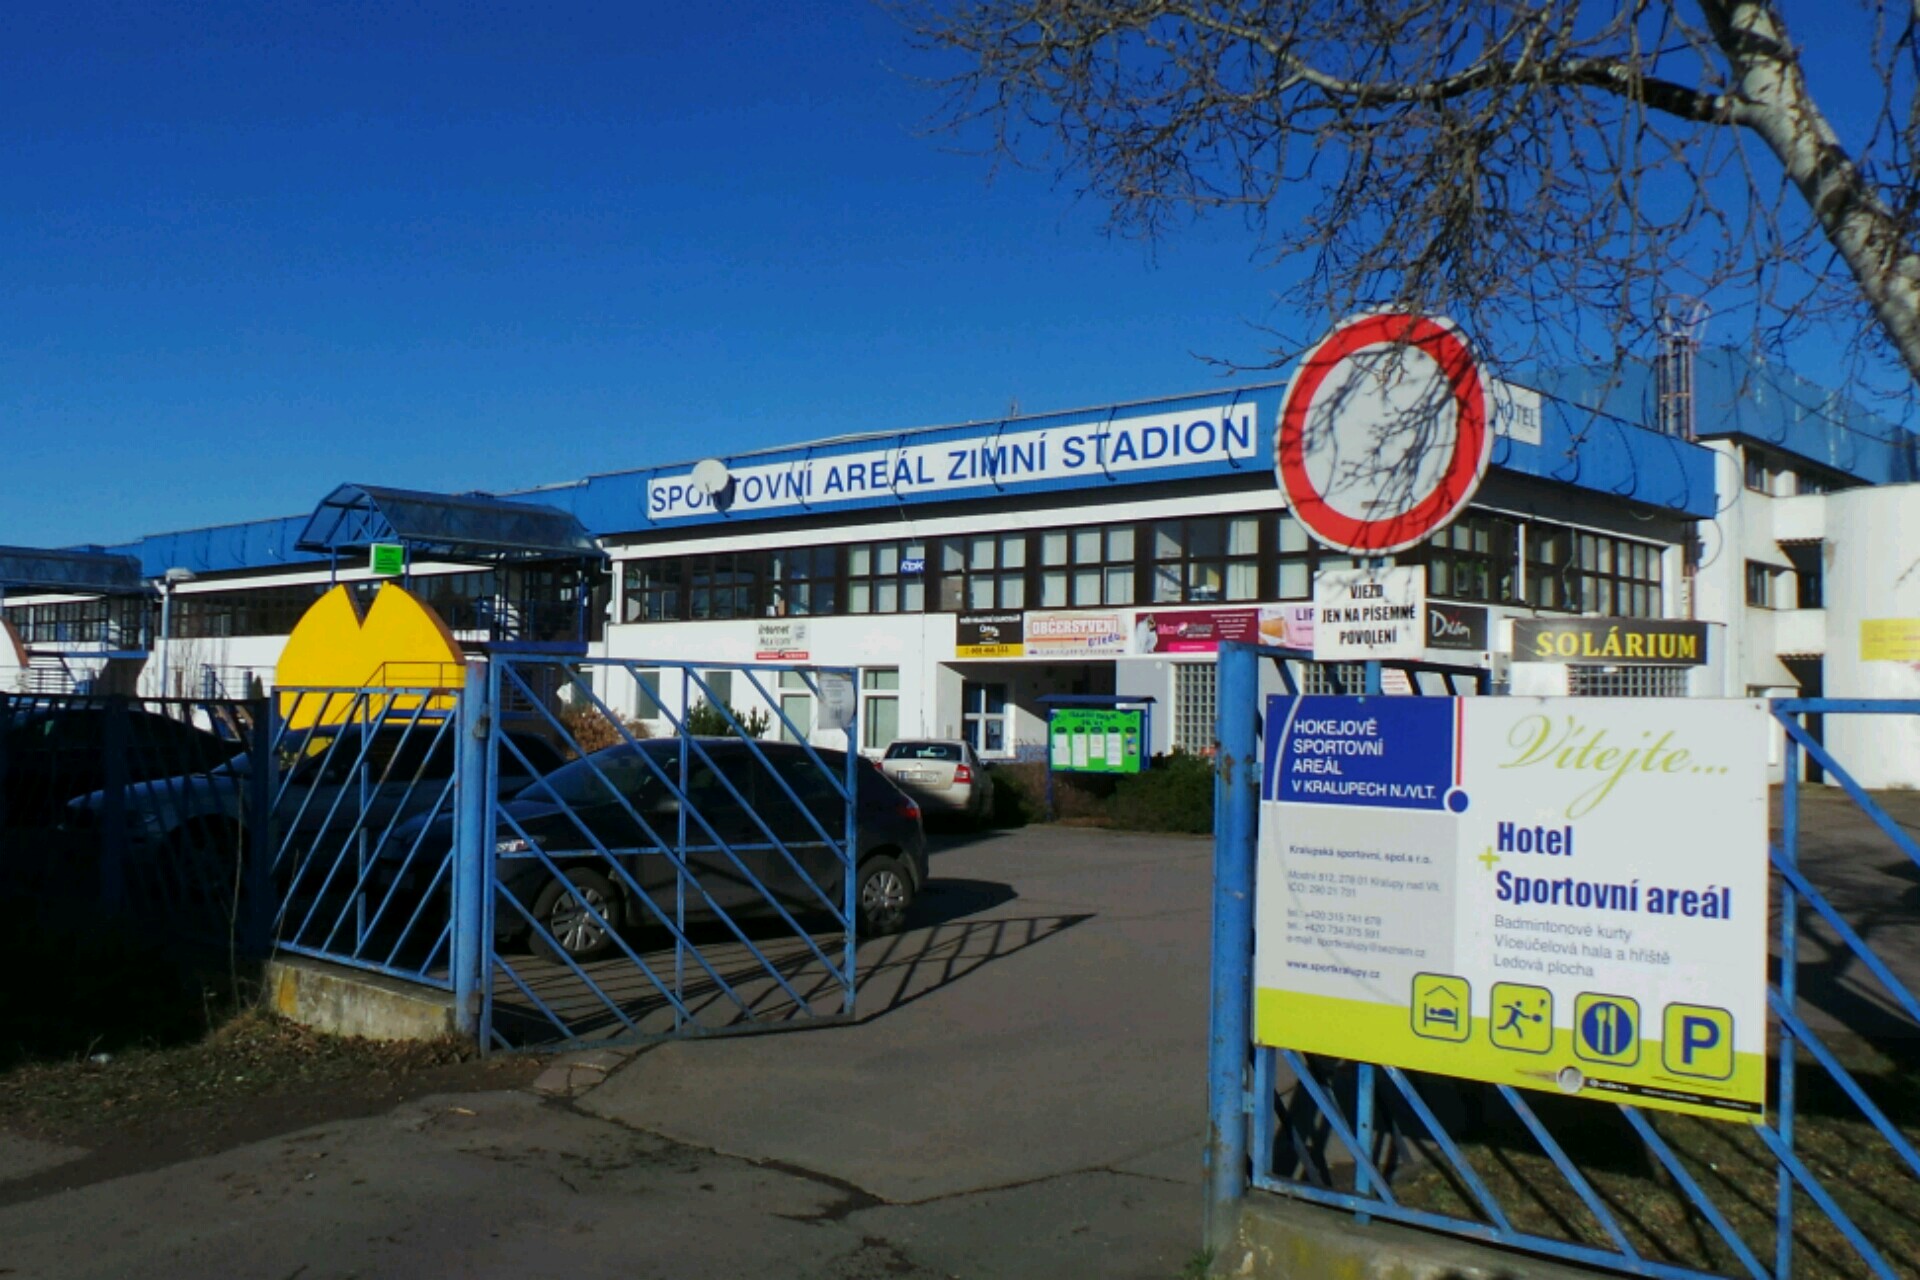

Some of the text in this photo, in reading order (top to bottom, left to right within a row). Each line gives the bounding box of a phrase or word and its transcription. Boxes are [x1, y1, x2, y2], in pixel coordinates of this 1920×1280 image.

[824, 450, 935, 494] AREÁL
[948, 432, 1047, 481] ZIMNÍ
[1063, 414, 1250, 468] STADION
[1322, 604, 1416, 623] JEN NA PÍSEMNÉ
[1032, 618, 1117, 636] OBČERSTVENÍ
[1339, 628, 1398, 645] POVOLENÍ
[1536, 626, 1697, 659] SOLÁRIUM
[1293, 738, 1384, 757] SPORTOVNÍ
[1292, 757, 1343, 775] AREÁL
[1292, 780, 1302, 792] V
[1304, 780, 1387, 797] KRALUPECH
[1497, 821, 1573, 856] Hotel
[1496, 870, 1731, 920] Sportovní areál
[1494, 914, 1632, 944] Badmintonové kurty
[1582, 943, 1612, 959] hala
[1616, 950, 1625, 960] a
[1493, 954, 1595, 977] Ledová plocha
[1682, 1015, 1720, 1065] P
